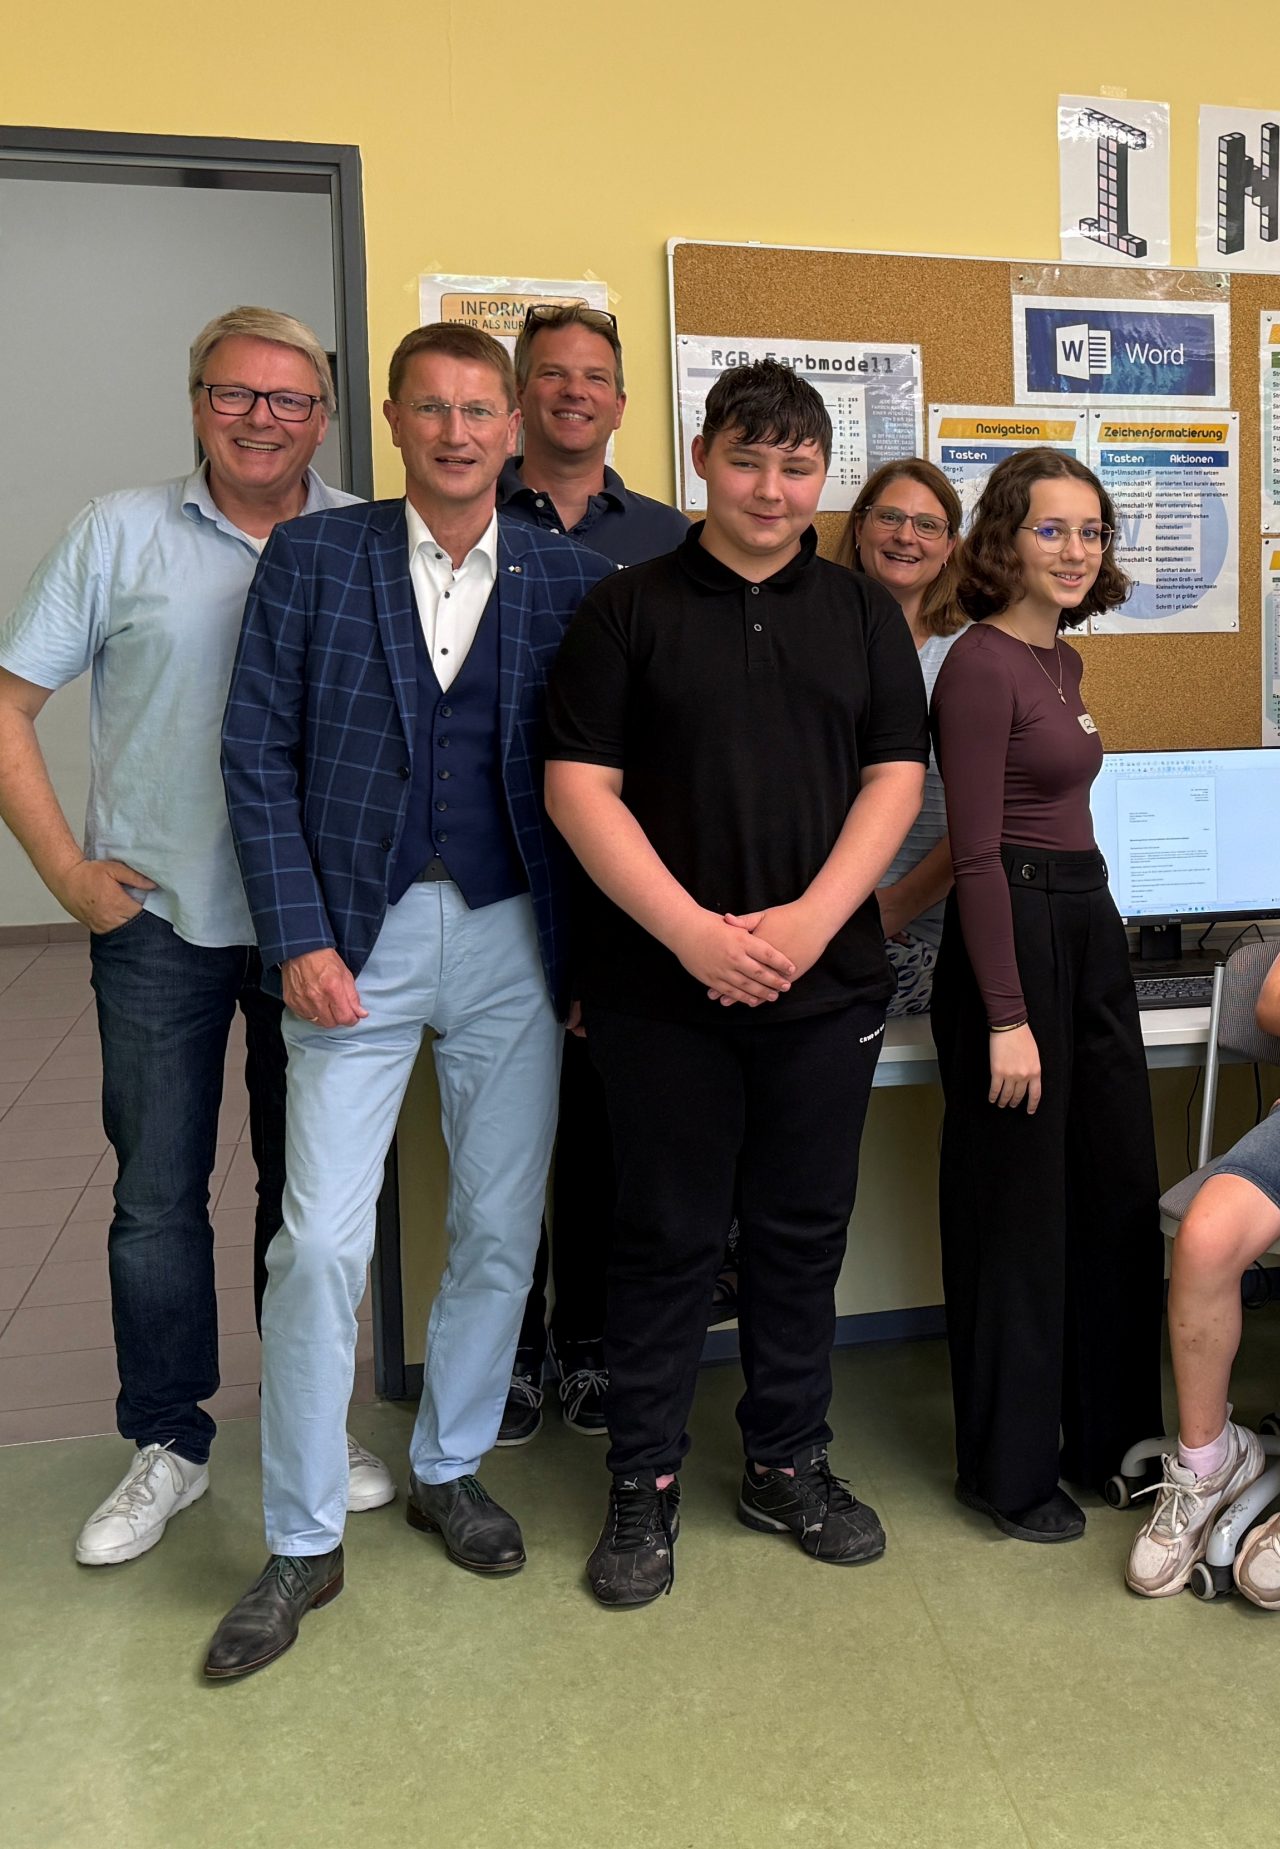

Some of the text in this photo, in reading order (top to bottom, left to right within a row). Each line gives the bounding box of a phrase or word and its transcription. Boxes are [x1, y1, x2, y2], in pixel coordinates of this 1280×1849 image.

[483, 320, 501, 330] ALS
[504, 320, 525, 330] NUR
[1062, 340, 1084, 362] W
[1125, 342, 1185, 365] Word
[976, 423, 1040, 437] Navigation
[1104, 427, 1223, 441] Zeichenformatierung
[949, 450, 987, 460] Tasten
[1108, 454, 1214, 464] Tasten Aktionen
